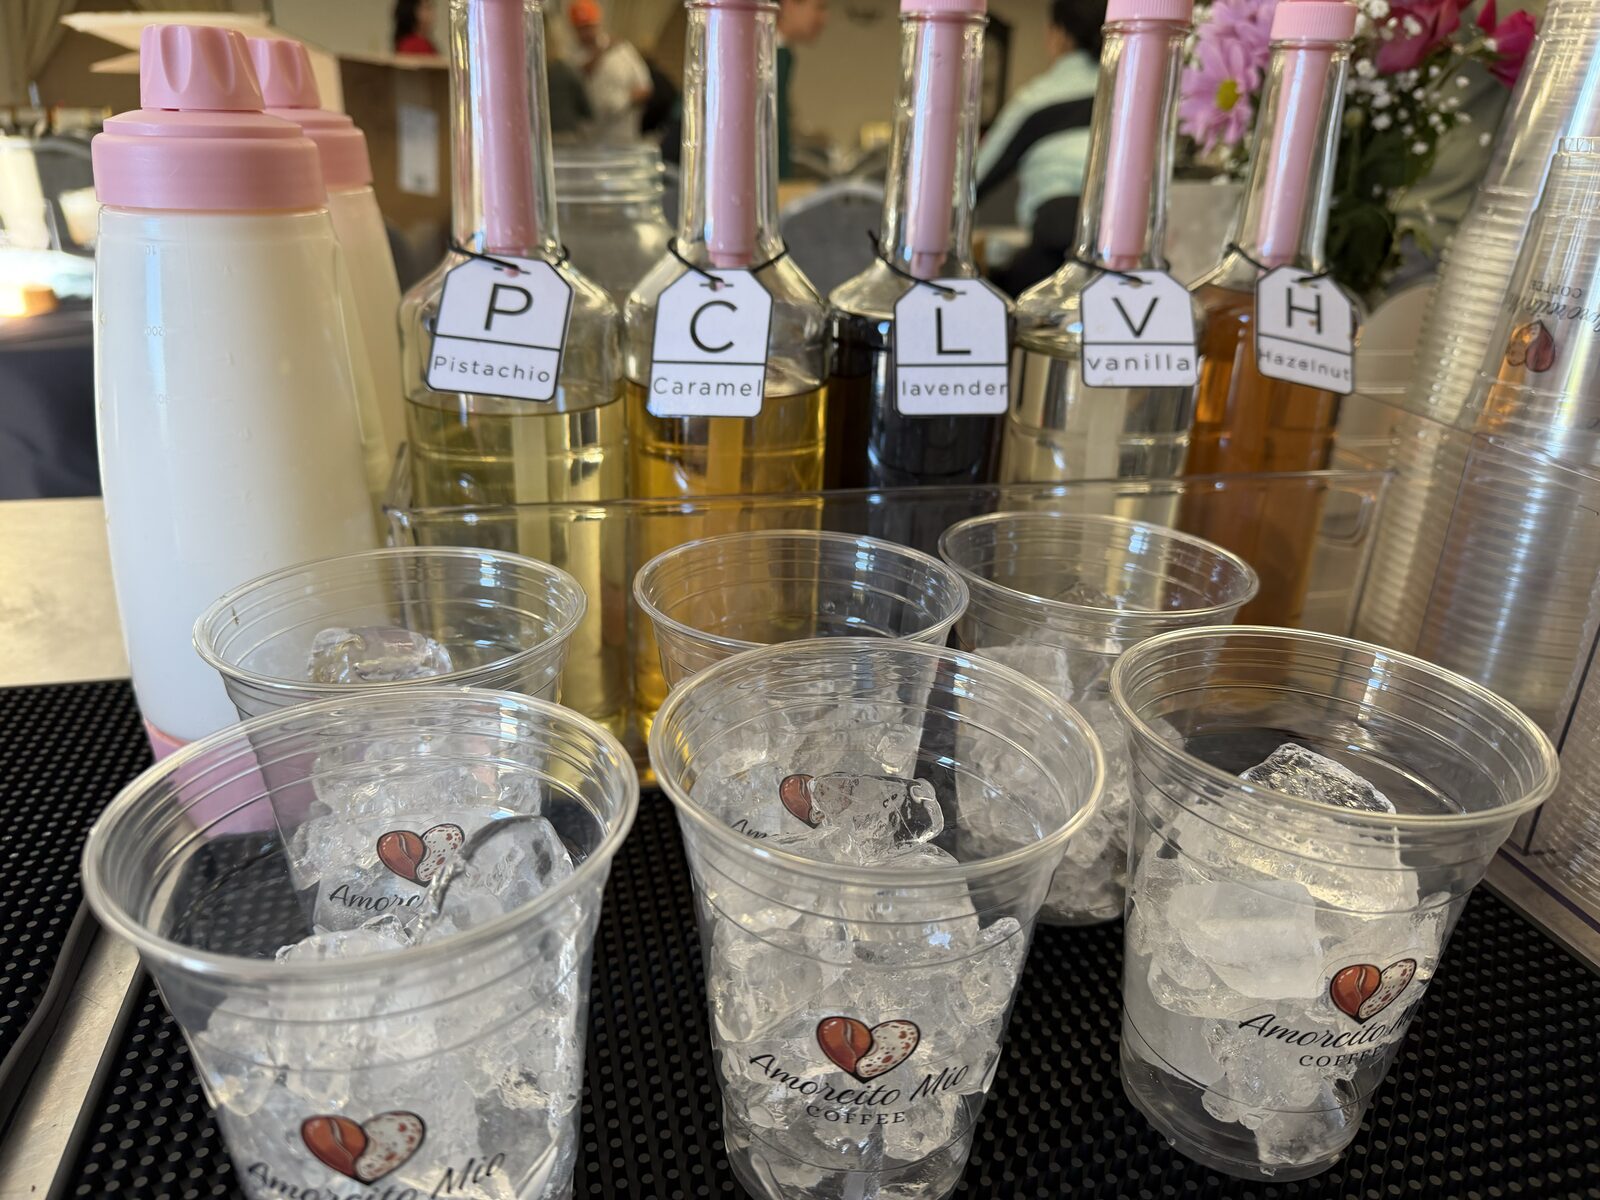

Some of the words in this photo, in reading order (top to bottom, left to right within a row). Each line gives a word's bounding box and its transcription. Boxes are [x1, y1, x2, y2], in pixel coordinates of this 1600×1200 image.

[484, 283, 533, 331] P
[1112, 297, 1159, 338] V
[1286, 287, 1322, 334] H
[690, 299, 738, 353] C
[935, 308, 971, 355] L
[433, 355, 550, 384] Pistachio
[1086, 352, 1190, 372] vanilla
[652, 376, 762, 397] Caramel
[902, 379, 1008, 397] lavender
[328, 884, 422, 911] Amorc
[1238, 1013, 1386, 1048] Amorcito
[749, 1053, 901, 1105] Amorcito
[806, 1105, 905, 1125] COFFEE
